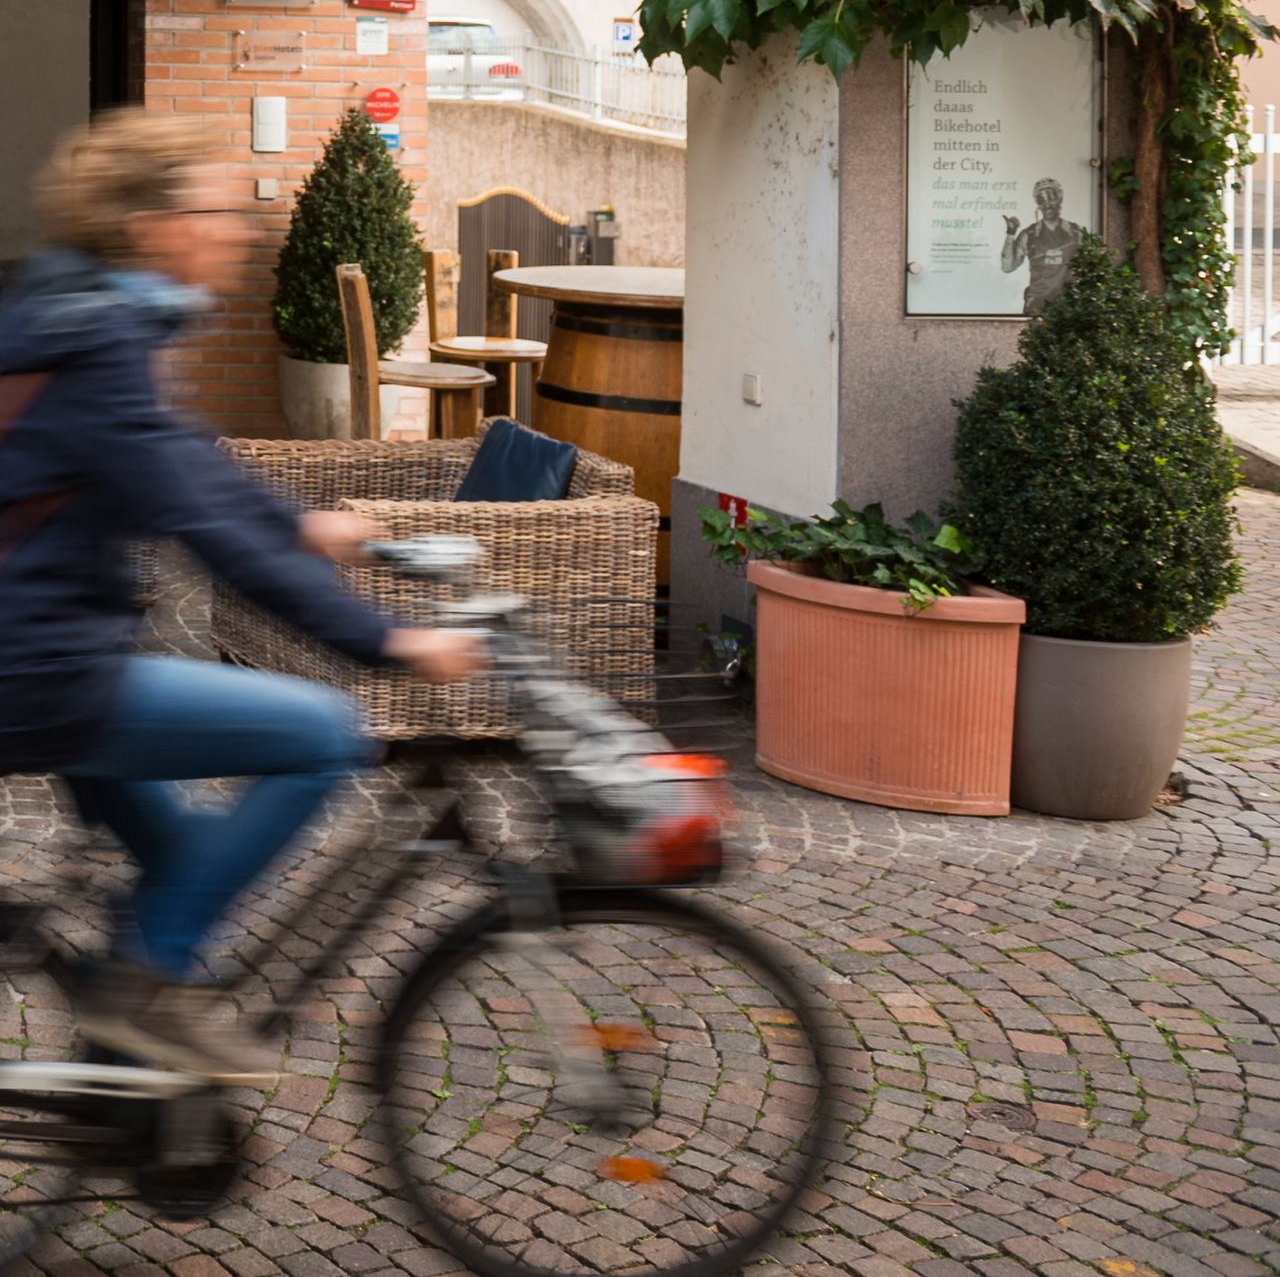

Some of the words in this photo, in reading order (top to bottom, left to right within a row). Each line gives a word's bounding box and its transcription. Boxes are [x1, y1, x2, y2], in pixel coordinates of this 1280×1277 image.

[933, 79, 988, 94] Endlich
[933, 98, 974, 113] daaas
[933, 118, 1001, 133] Bikehotel
[933, 138, 982, 152] mitten
[985, 138, 1000, 152] in
[932, 157, 957, 170] der
[960, 157, 993, 174] City,
[931, 176, 956, 190] das
[958, 180, 989, 190] man
[991, 178, 1018, 191] erst
[931, 196, 958, 210] mal
[959, 196, 1018, 212] erfinden
[931, 215, 984, 229] musste!
